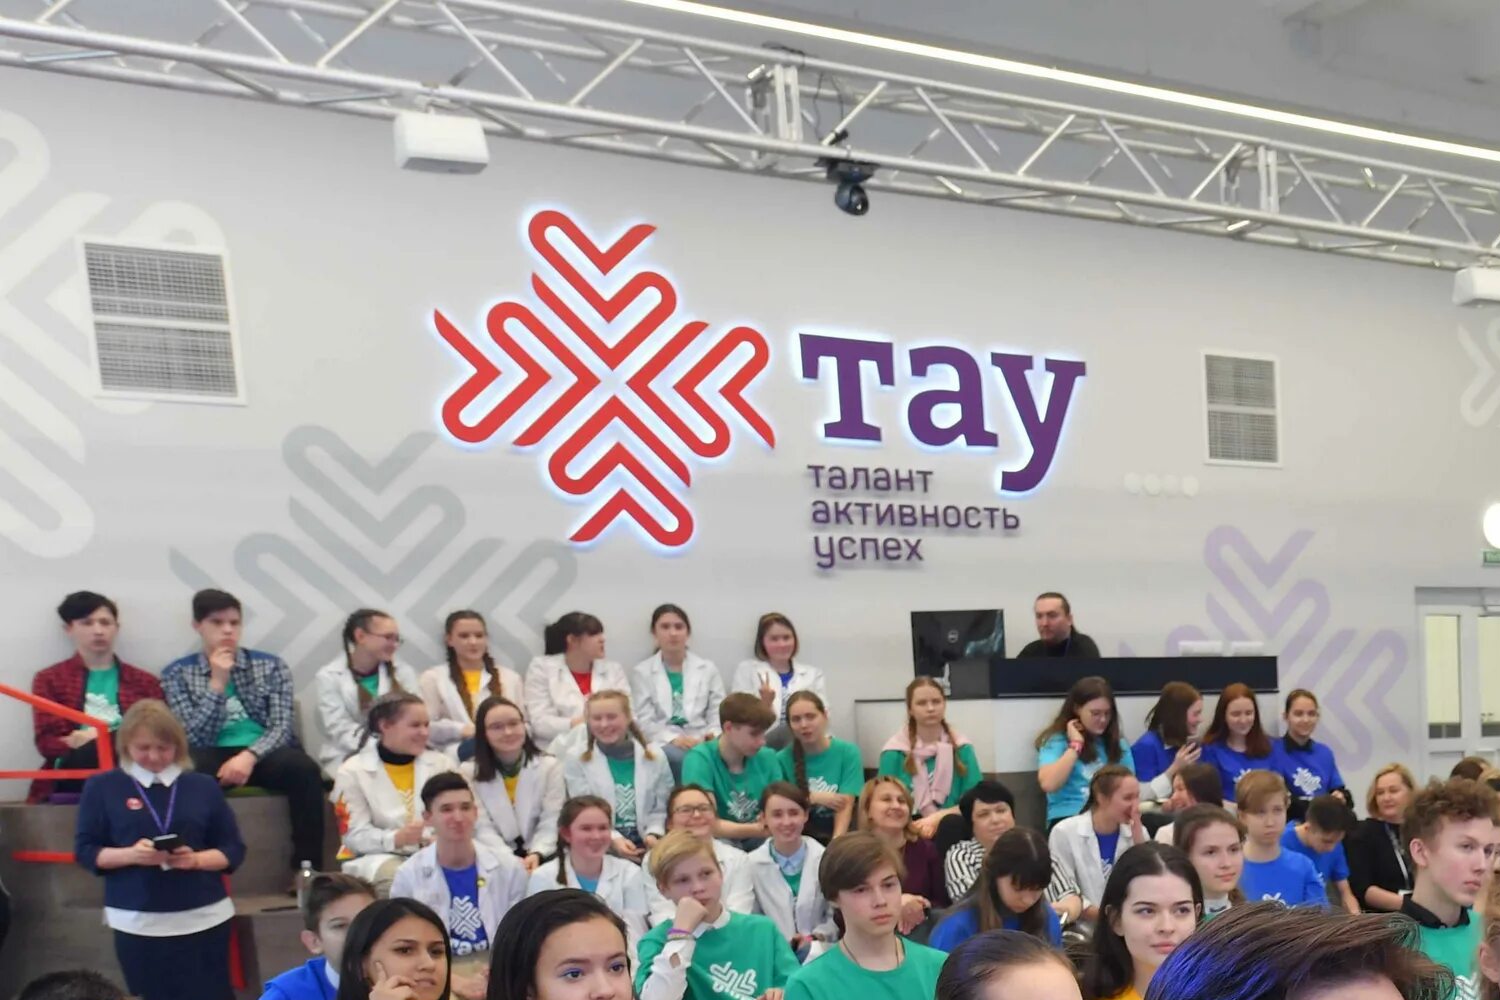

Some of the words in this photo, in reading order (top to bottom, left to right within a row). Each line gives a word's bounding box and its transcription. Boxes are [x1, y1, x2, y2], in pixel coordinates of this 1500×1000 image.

[799, 333, 1087, 492] тау
[807, 464, 933, 493] талант
[812, 499, 1020, 530] активность
[813, 535, 924, 569] успех
